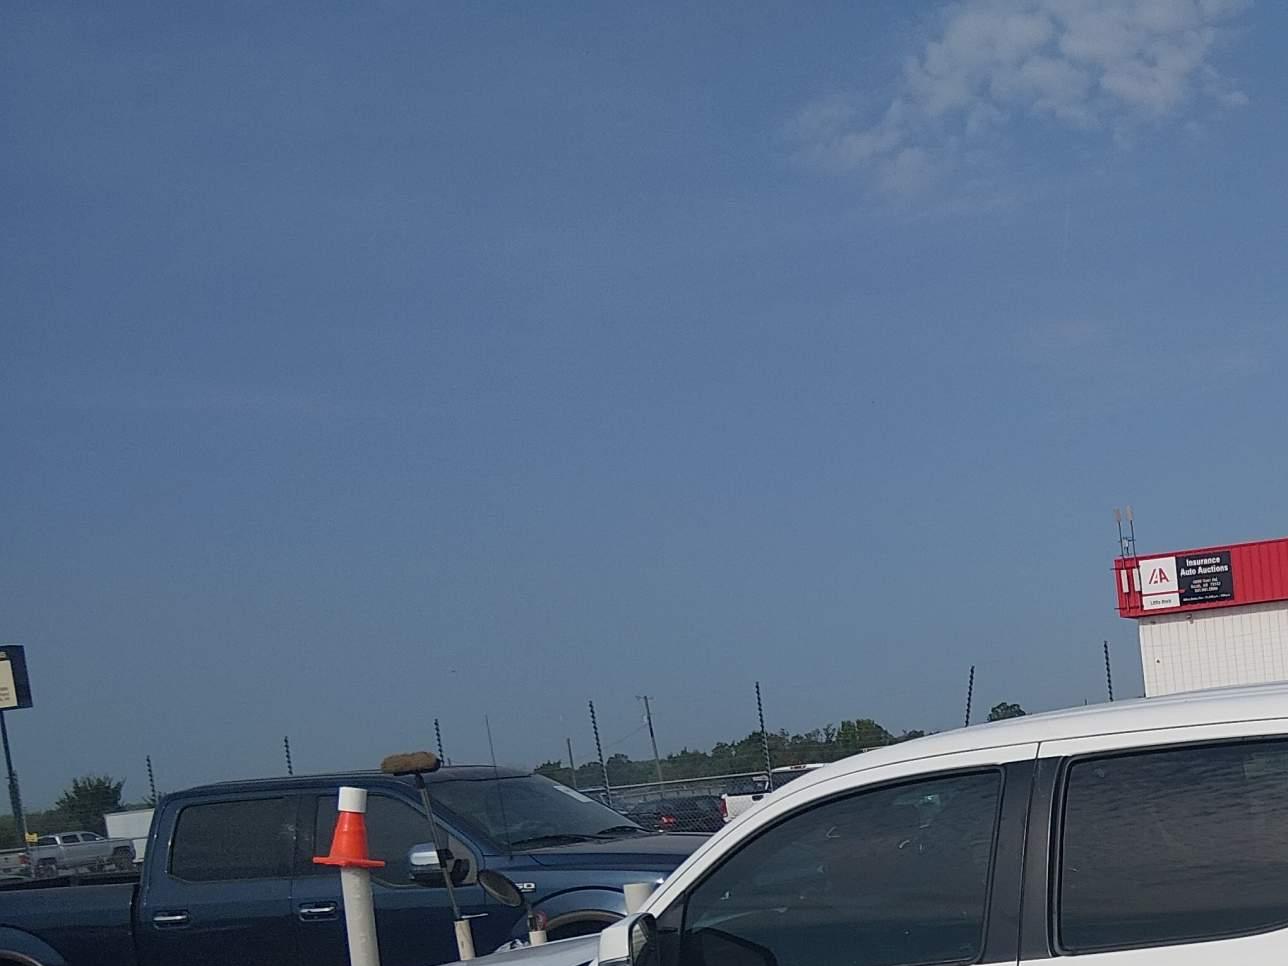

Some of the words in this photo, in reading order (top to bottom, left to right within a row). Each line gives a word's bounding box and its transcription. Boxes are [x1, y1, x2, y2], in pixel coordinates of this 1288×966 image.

[1186, 557, 1220, 566] Insurance
[1180, 567, 1197, 577] Auto
[1198, 565, 1229, 574] Auctions
